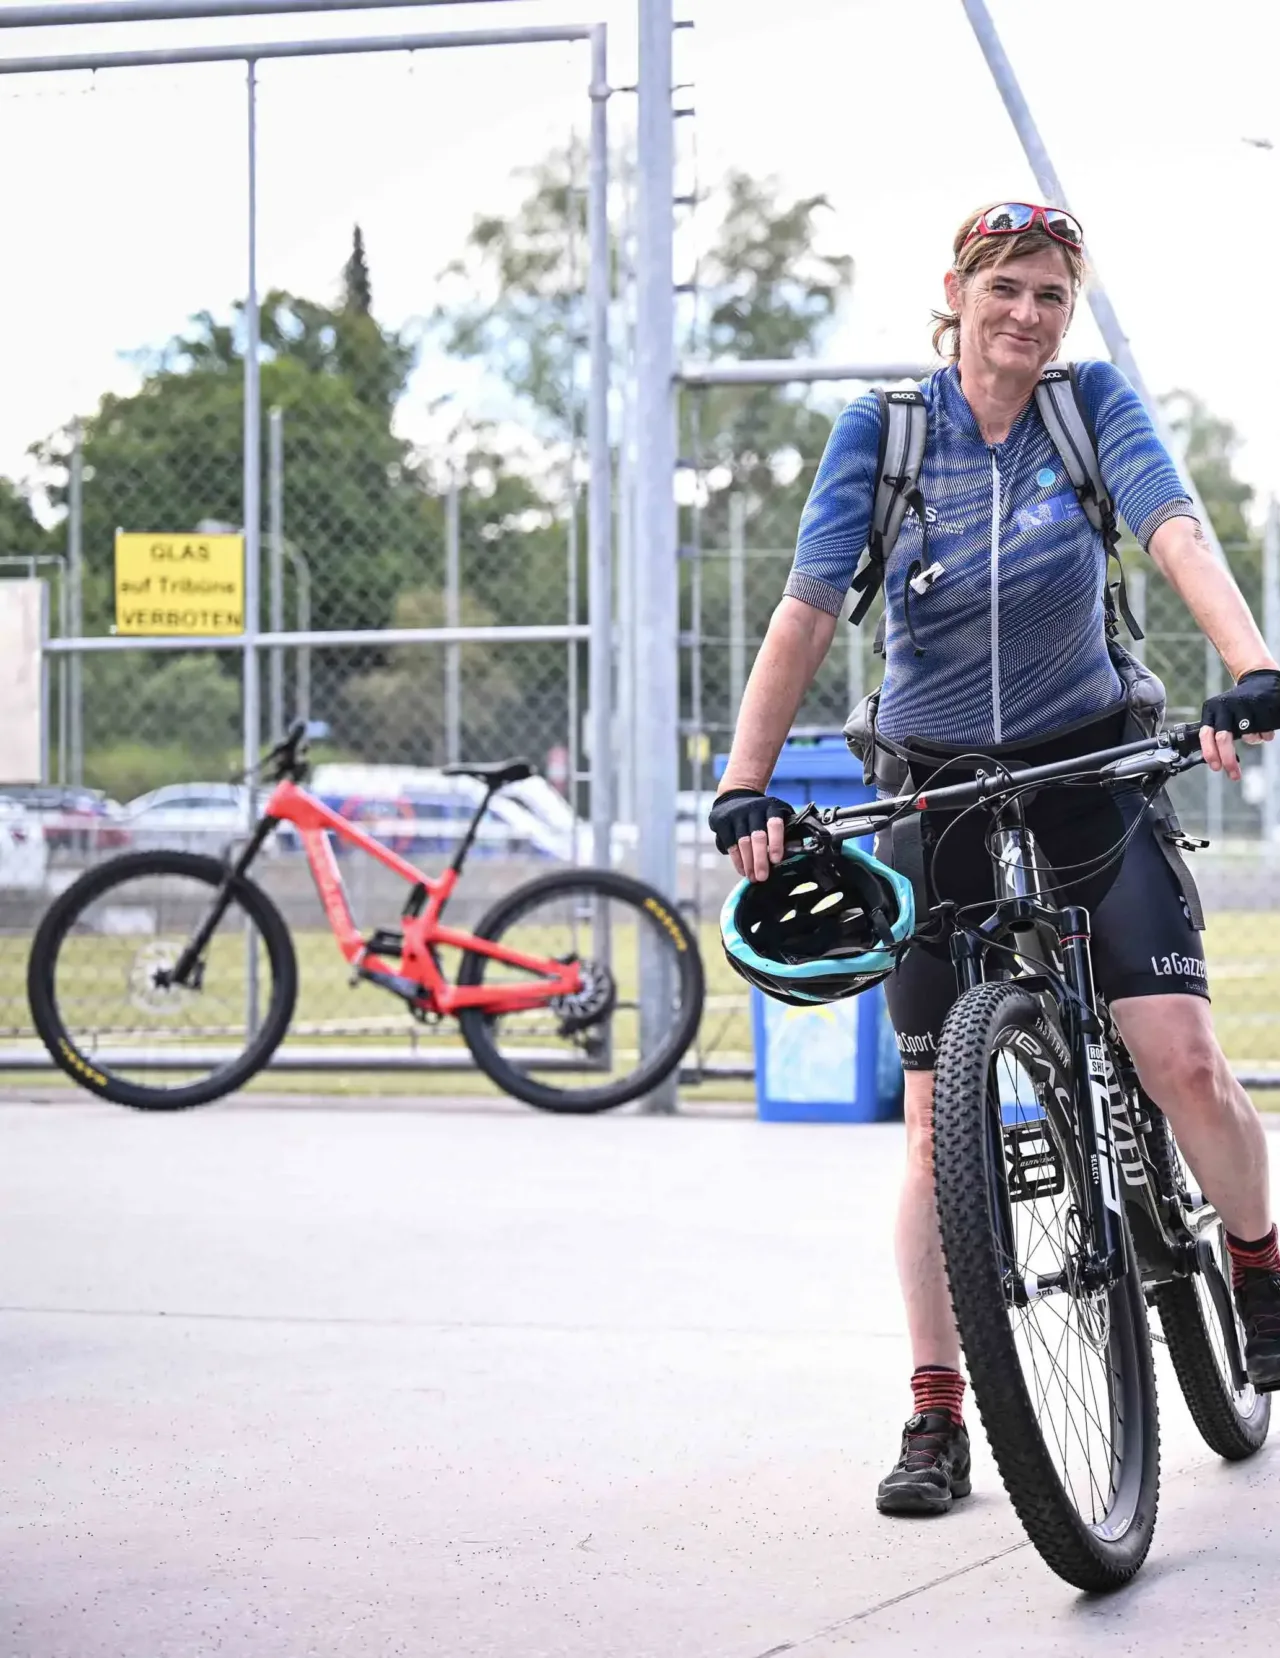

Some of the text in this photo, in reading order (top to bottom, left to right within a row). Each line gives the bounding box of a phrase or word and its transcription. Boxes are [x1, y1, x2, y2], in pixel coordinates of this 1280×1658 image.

[150, 543, 210, 561] GLAS
[121, 577, 236, 594] auf Tribüne
[122, 609, 241, 627] VERBOTEN
